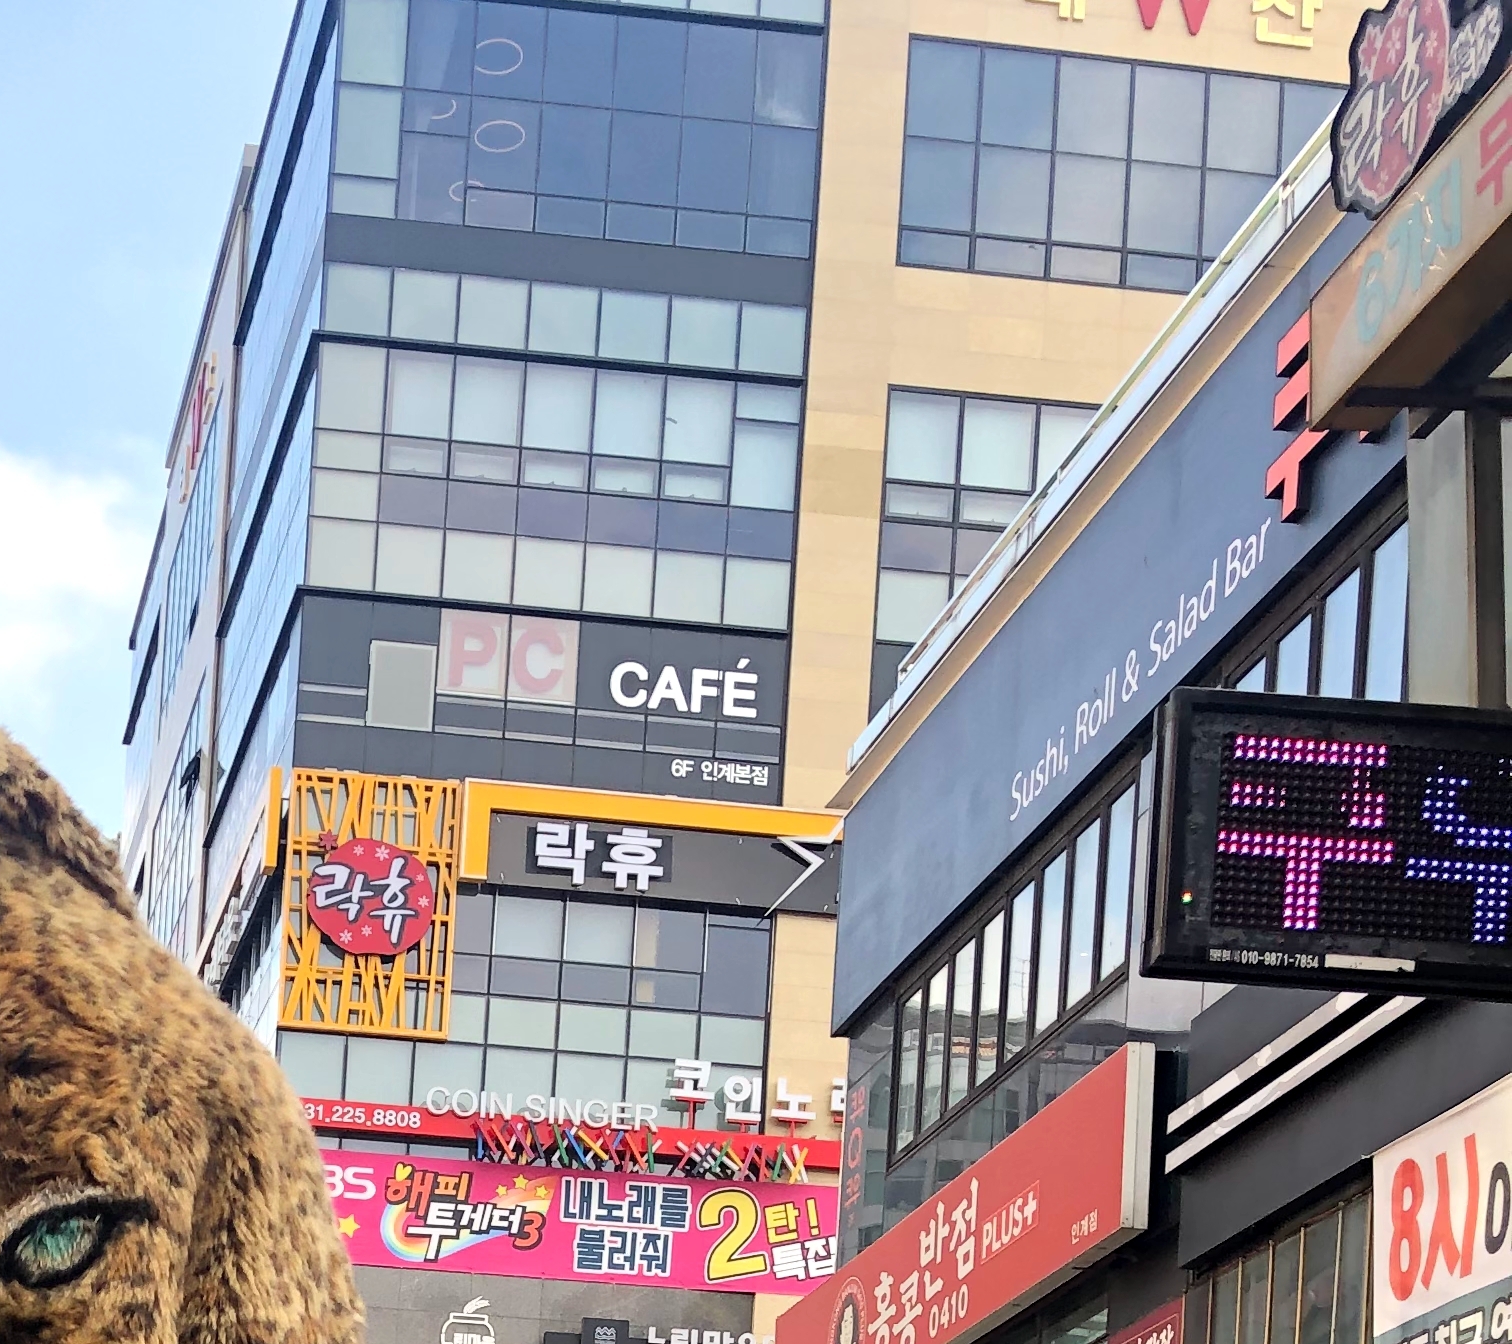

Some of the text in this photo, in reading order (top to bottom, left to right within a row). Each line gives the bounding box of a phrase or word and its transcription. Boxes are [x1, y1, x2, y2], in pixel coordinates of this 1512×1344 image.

[448, 614, 758, 718] PC CAFÉ
[1008, 517, 1271, 821] Sushi, Roll & Salad Bar
[670, 759, 768, 785] 6F 인계본점
[535, 822, 664, 892] 락휴
[313, 857, 418, 945] 락휴
[1241, 951, 1319, 968] 010-9871-7854
[426, 1086, 513, 1121] COIN
[525, 1094, 659, 1133] SINGER
[385, 1163, 471, 1213] 해피
[407, 1202, 838, 1282] 투게더3 불러줘 특집
[981, 1189, 1038, 1254] PLUS+
[1070, 1208, 1099, 1245] 인계점
[928, 1284, 969, 1339] 0410
